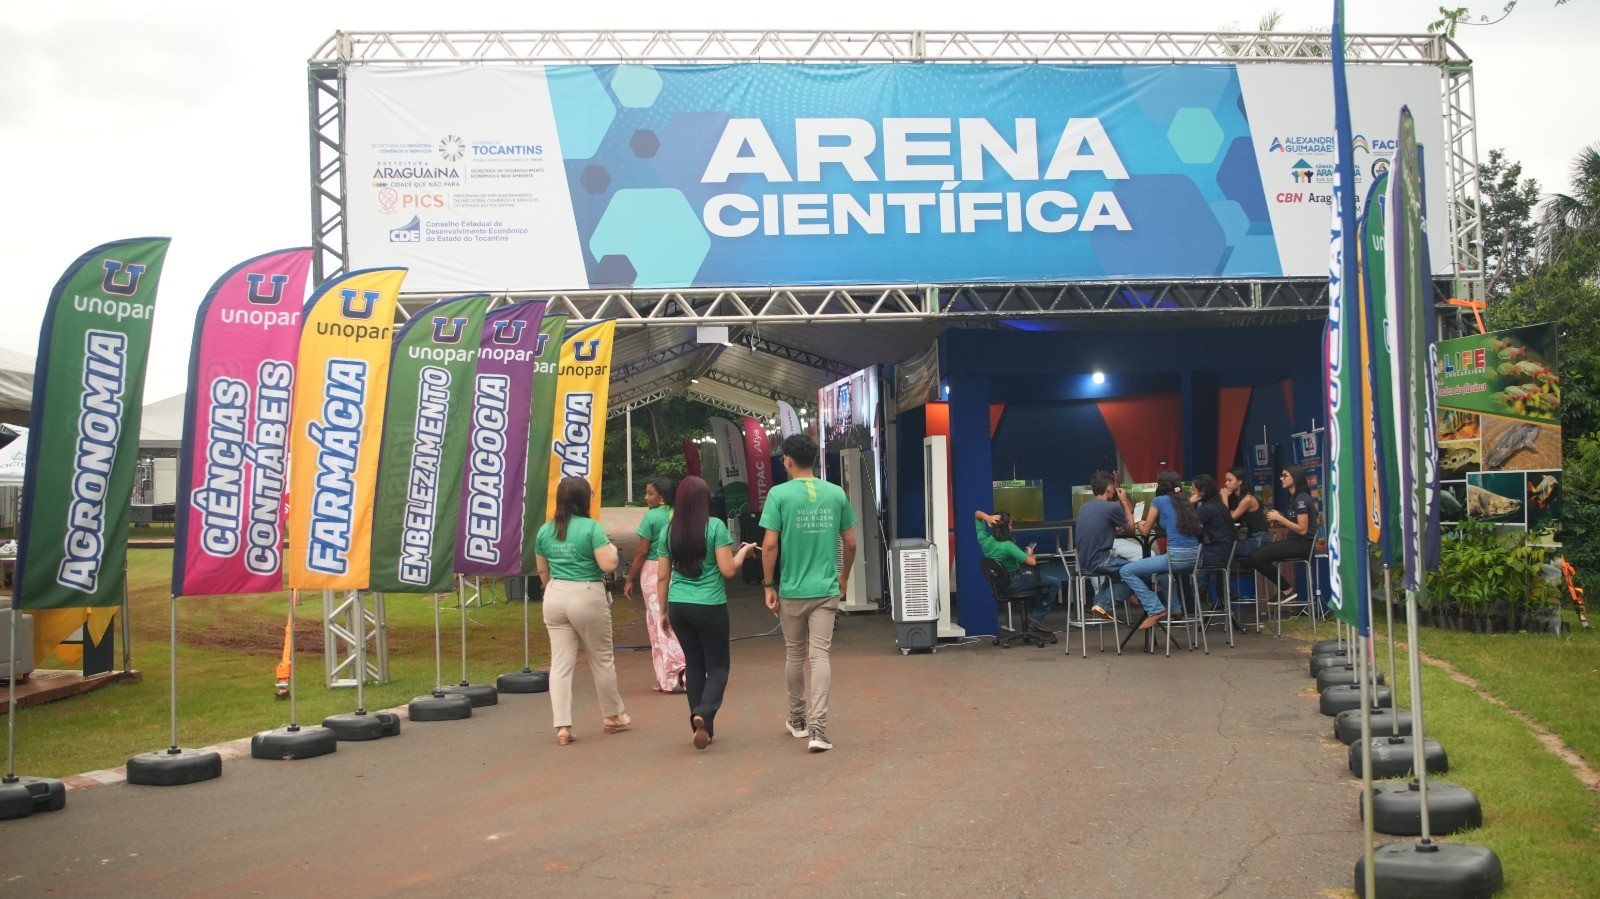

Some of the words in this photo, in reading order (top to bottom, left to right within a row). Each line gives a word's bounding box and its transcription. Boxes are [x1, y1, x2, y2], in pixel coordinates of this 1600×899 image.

[472, 145, 543, 155] TOCANTINS
[700, 117, 1131, 183] ARENA
[402, 194, 444, 208] PICS
[702, 181, 1133, 237] CIENTÍFICA
[1276, 192, 1303, 203] CBN
[390, 230, 420, 242] CDE
[425, 227, 487, 235] Desenvolvimento
[488, 227, 528, 235] Econômico
[426, 220, 459, 228] Conselho
[461, 220, 492, 228] Estadual
[437, 234, 465, 242] Estado
[74, 294, 154, 322] unopar
[221, 307, 300, 330] unopar
[316, 321, 389, 342] unopar
[408, 345, 475, 365] unopar
[1443, 348, 1486, 373] LIFE
[752, 429, 763, 453] Afya
[57, 330, 127, 594] AGRONOMIA
[192, 376, 250, 557] CIÊNCIAS
[243, 361, 295, 575] CONTÁBEIS
[306, 358, 369, 576] FARMÁCIA
[465, 374, 510, 565] PEDAGOGIA
[399, 366, 451, 585] EMBELEZAMENTO
